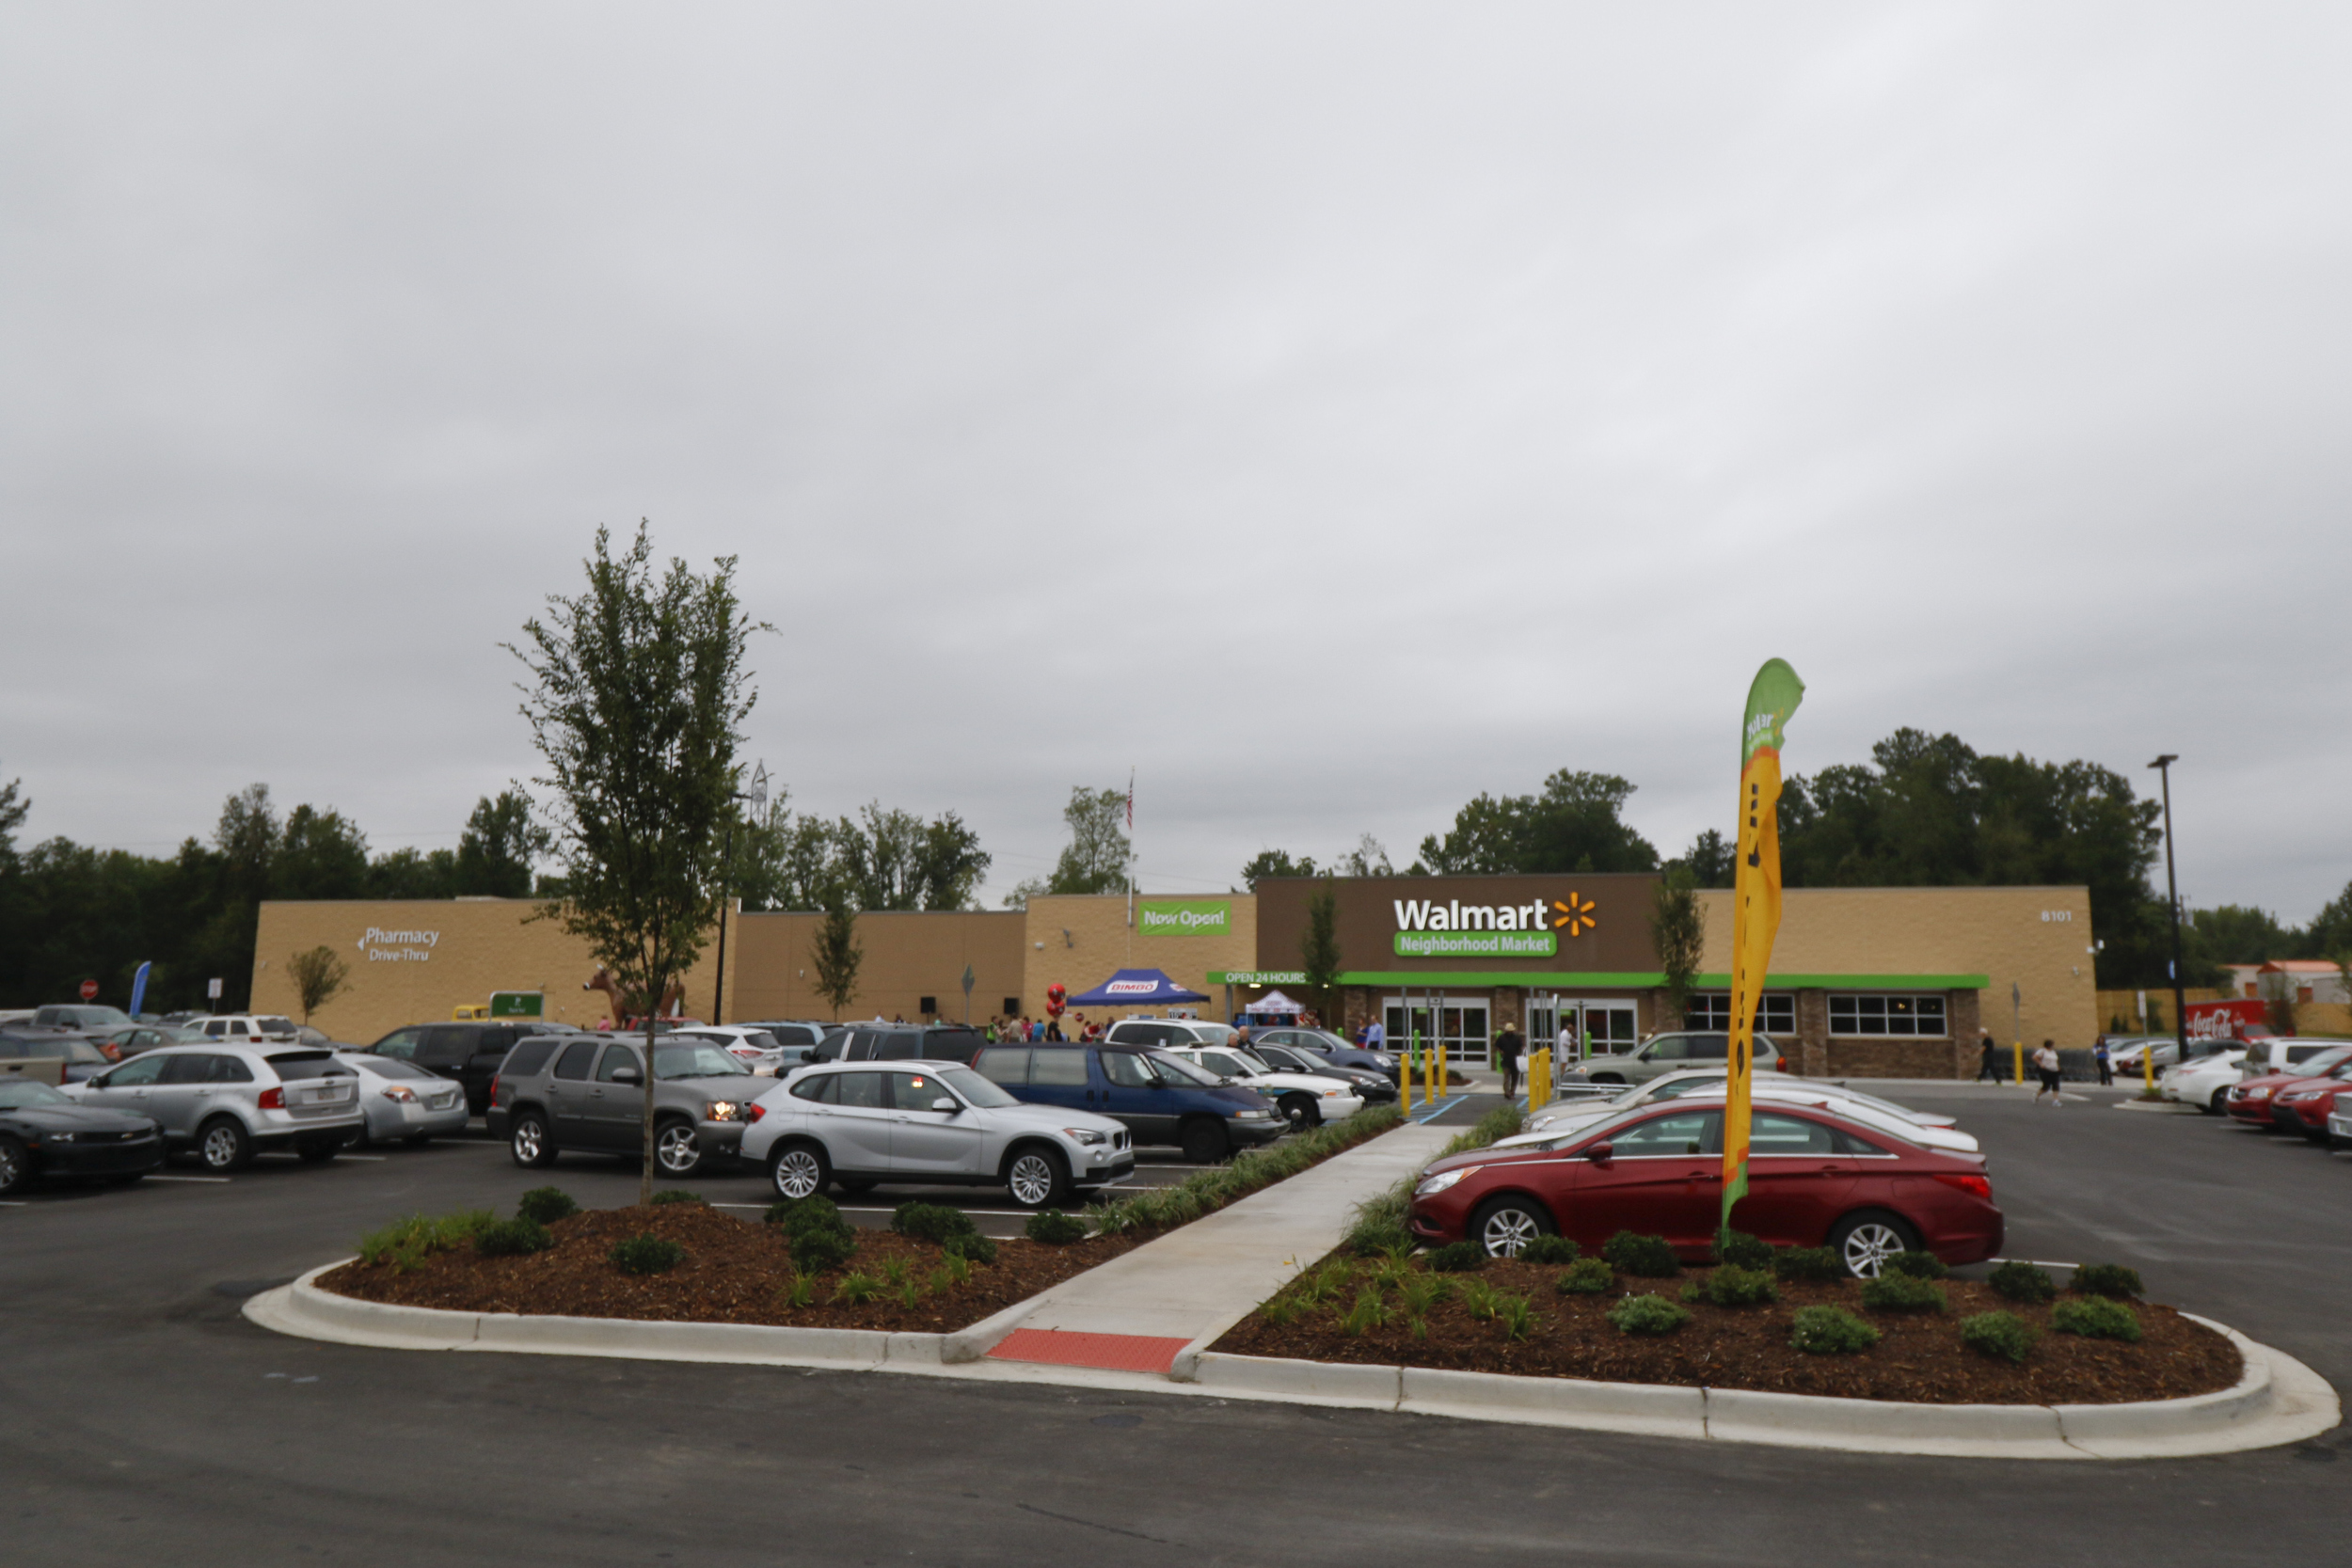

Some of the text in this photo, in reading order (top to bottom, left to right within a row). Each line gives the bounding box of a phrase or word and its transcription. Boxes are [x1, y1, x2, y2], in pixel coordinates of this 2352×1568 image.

[1144, 910, 1225, 928] Now Open!
[1393, 898, 1548, 931] Walmart
[2041, 910, 2072, 922] 8101
[365, 927, 439, 948] Pharmacy
[1400, 936, 1550, 956] Neighborhood Market
[369, 948, 429, 961] Drive-Thru
[1226, 972, 1306, 983] OPEN 24 HOURS
[1111, 983, 1154, 991] BIMBO
